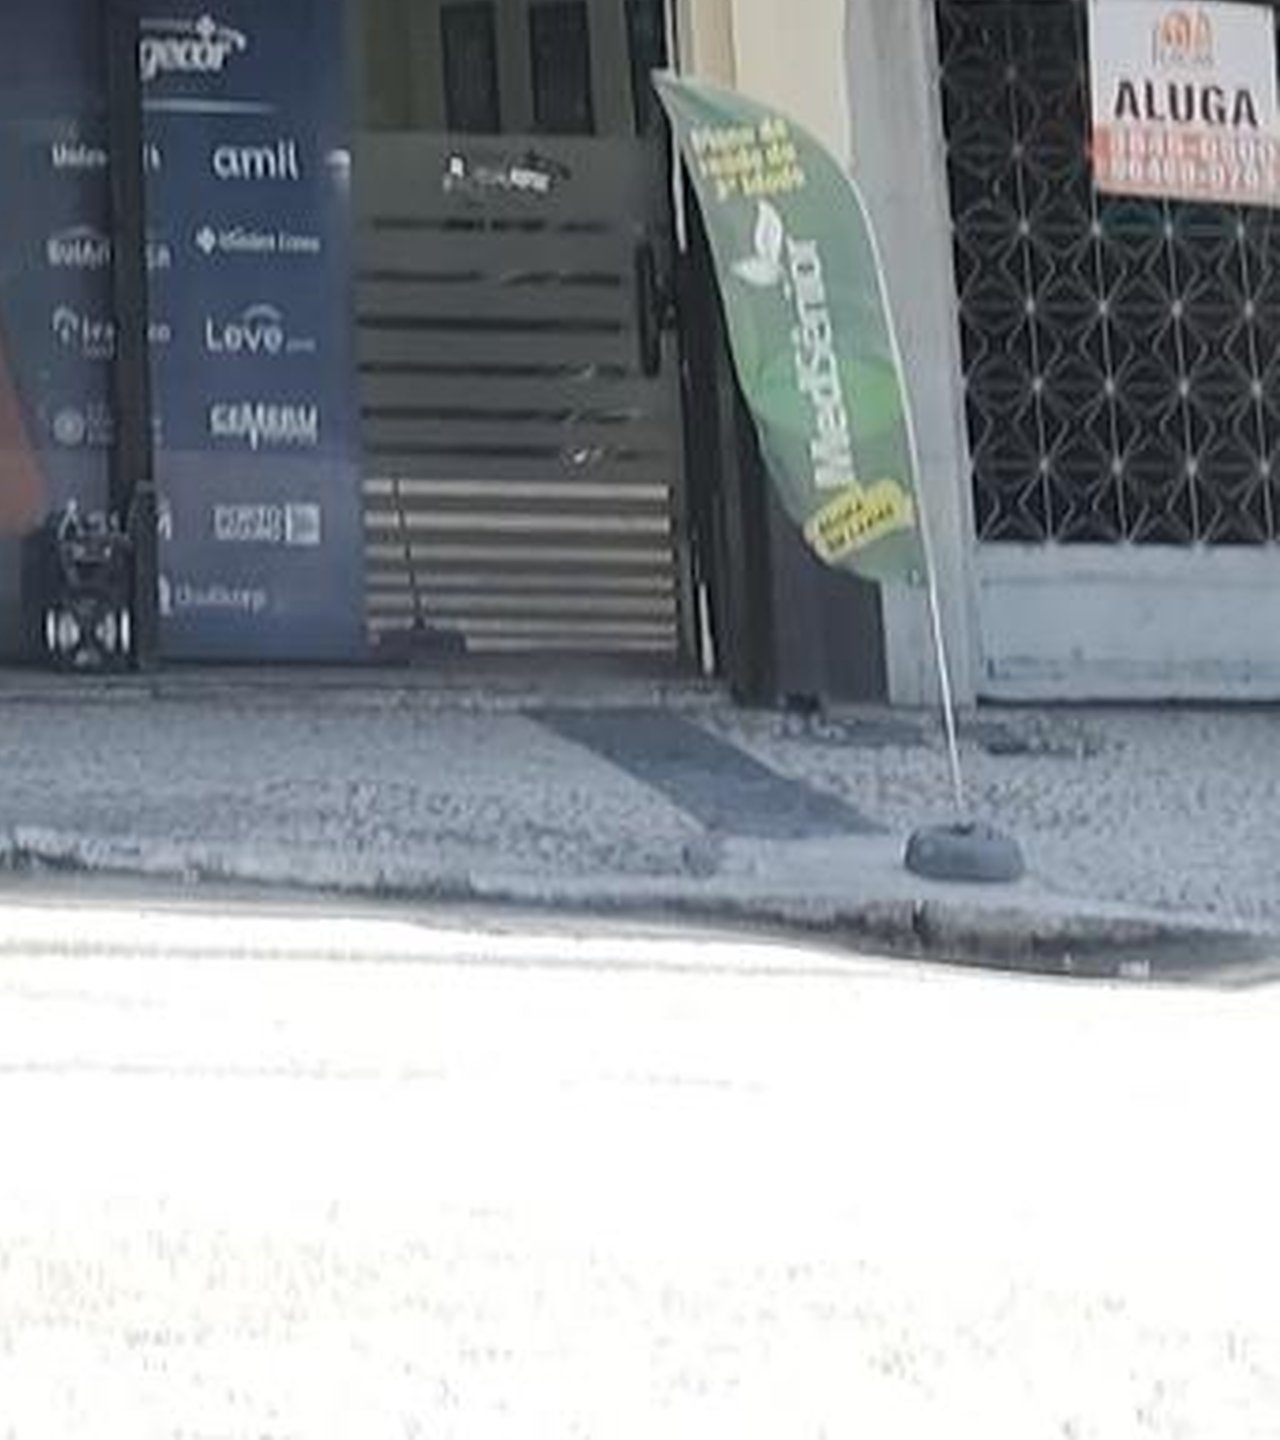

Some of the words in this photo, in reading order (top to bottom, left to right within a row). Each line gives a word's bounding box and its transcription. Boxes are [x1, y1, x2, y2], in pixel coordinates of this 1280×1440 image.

[140, 36, 232, 80] gecor
[1114, 79, 1260, 129] ALUGA
[212, 137, 301, 180] amil
